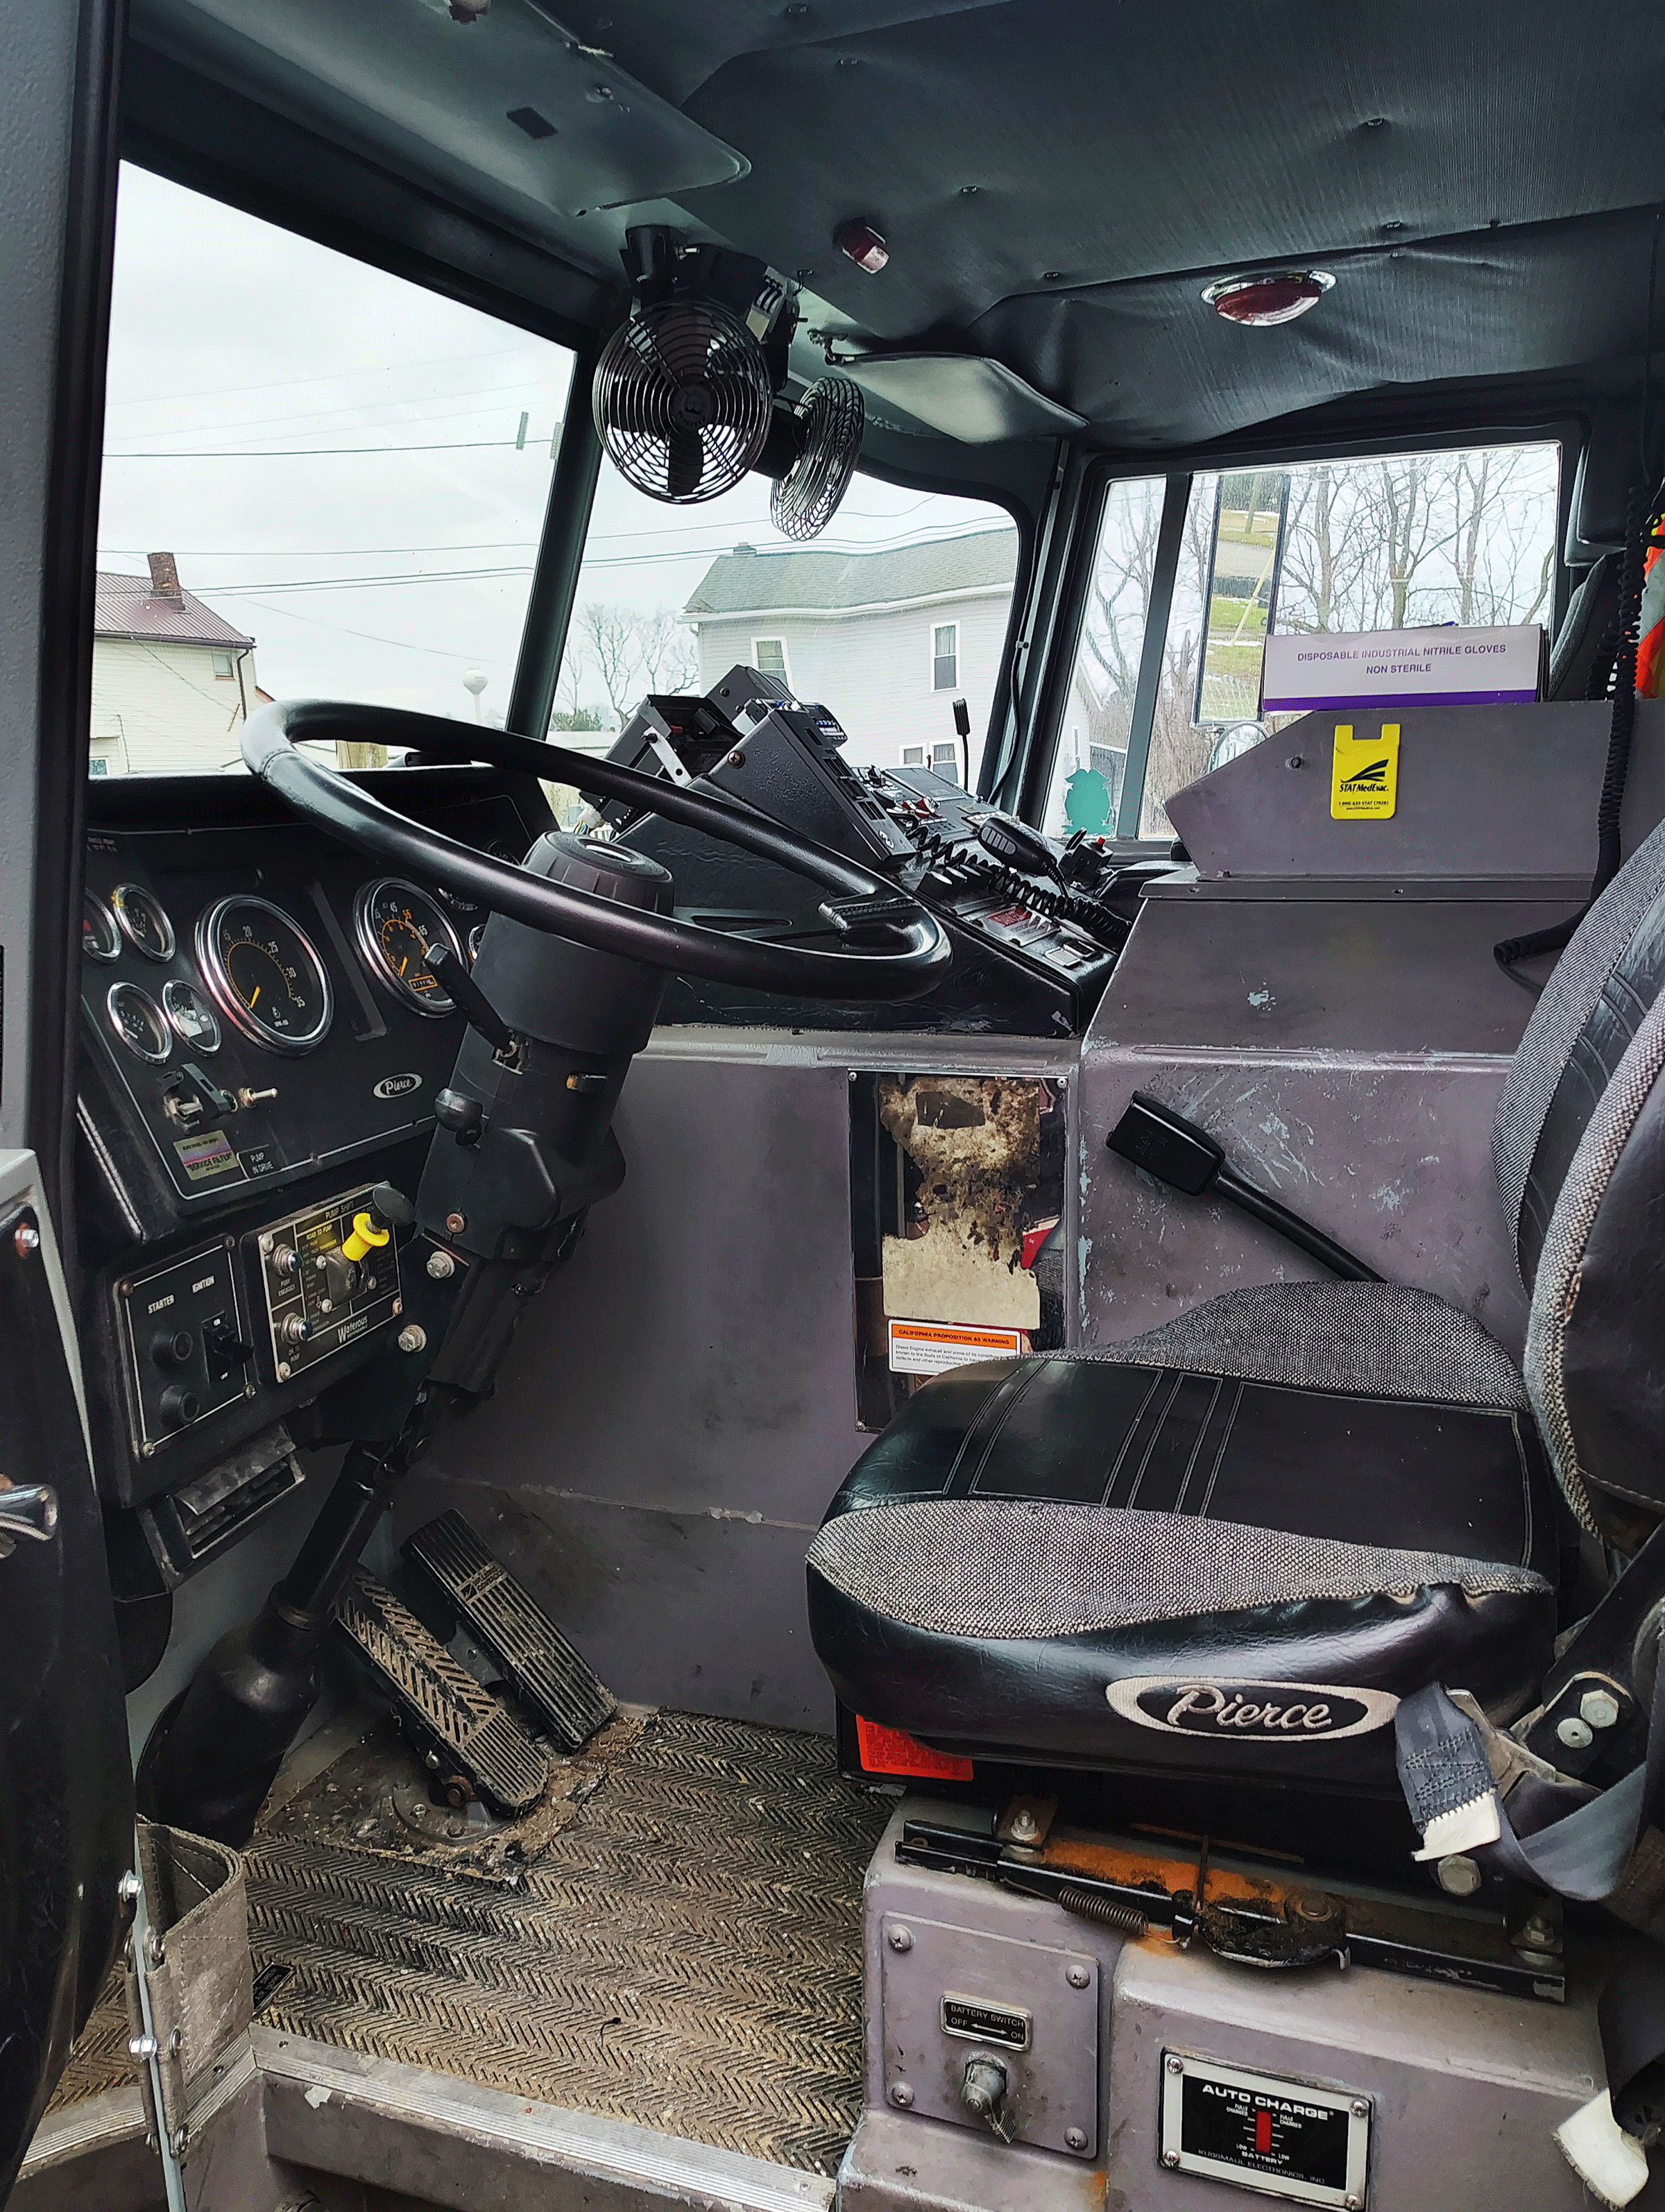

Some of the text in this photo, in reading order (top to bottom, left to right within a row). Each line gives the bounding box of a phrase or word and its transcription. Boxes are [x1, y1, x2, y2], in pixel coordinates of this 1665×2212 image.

[1297, 644, 1506, 661] DISPOSABLE INDUSTRIAL NITRILE GLOVES
[1366, 663, 1432, 674] NON STERILE
[1340, 783, 1357, 792] STAT
[390, 902, 398, 912] 45
[402, 909, 412, 920] 55
[242, 926, 253, 937] 20
[418, 924, 428, 936] 65
[268, 941, 279, 953] 25
[325, 1207, 340, 1220] PUMP
[341, 1201, 354, 1213] SHIFT
[148, 1294, 175, 1314] STARTER
[337, 1316, 368, 1343] Waterous
[898, 1329, 932, 1338] CALIFORNIA
[933, 1332, 972, 1341] PROPOSITION
[1167, 1683, 1332, 1729] Pierce
[951, 2005, 1024, 2028] BATTERY SWITCH
[951, 2017, 1024, 2041] OFF ON
[1202, 2084, 1329, 2120] AUTO CHARGE
[1236, 2143, 1247, 2151] LOW
[1241, 2151, 1283, 2166] BATTERY
[1278, 2153, 1290, 2161] LOW
